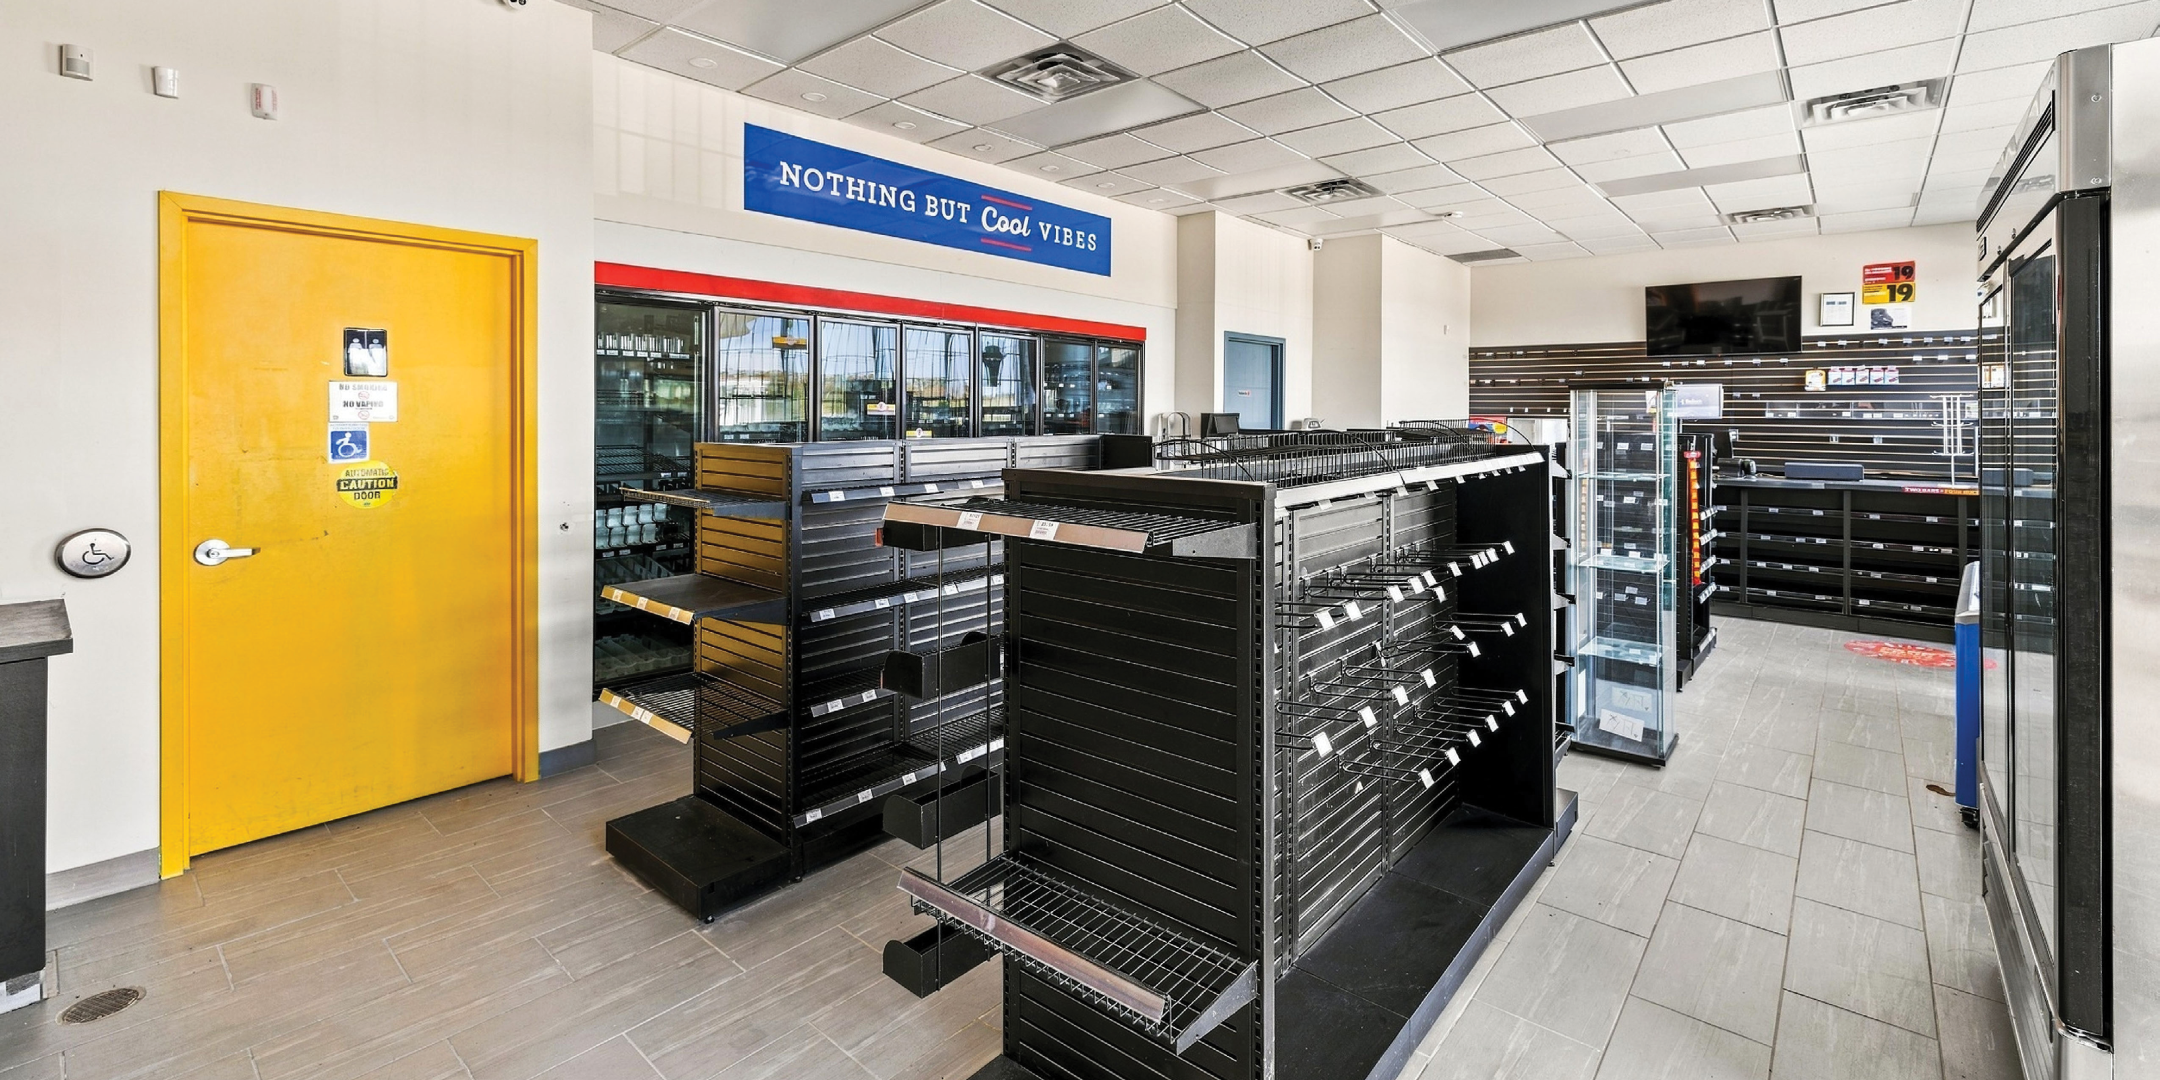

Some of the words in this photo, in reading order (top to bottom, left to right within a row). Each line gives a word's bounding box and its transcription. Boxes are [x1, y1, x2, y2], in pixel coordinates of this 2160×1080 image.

[779, 161, 916, 213] NOTHING
[924, 195, 971, 224] BUT
[981, 206, 1031, 237] Cool
[1039, 221, 1097, 251] VIBES
[1894, 266, 1914, 280] 19
[1887, 283, 1913, 302] 19
[345, 468, 389, 478] AUTOMATIC
[340, 478, 395, 490] CAUTION
[354, 491, 380, 500] DOOR
